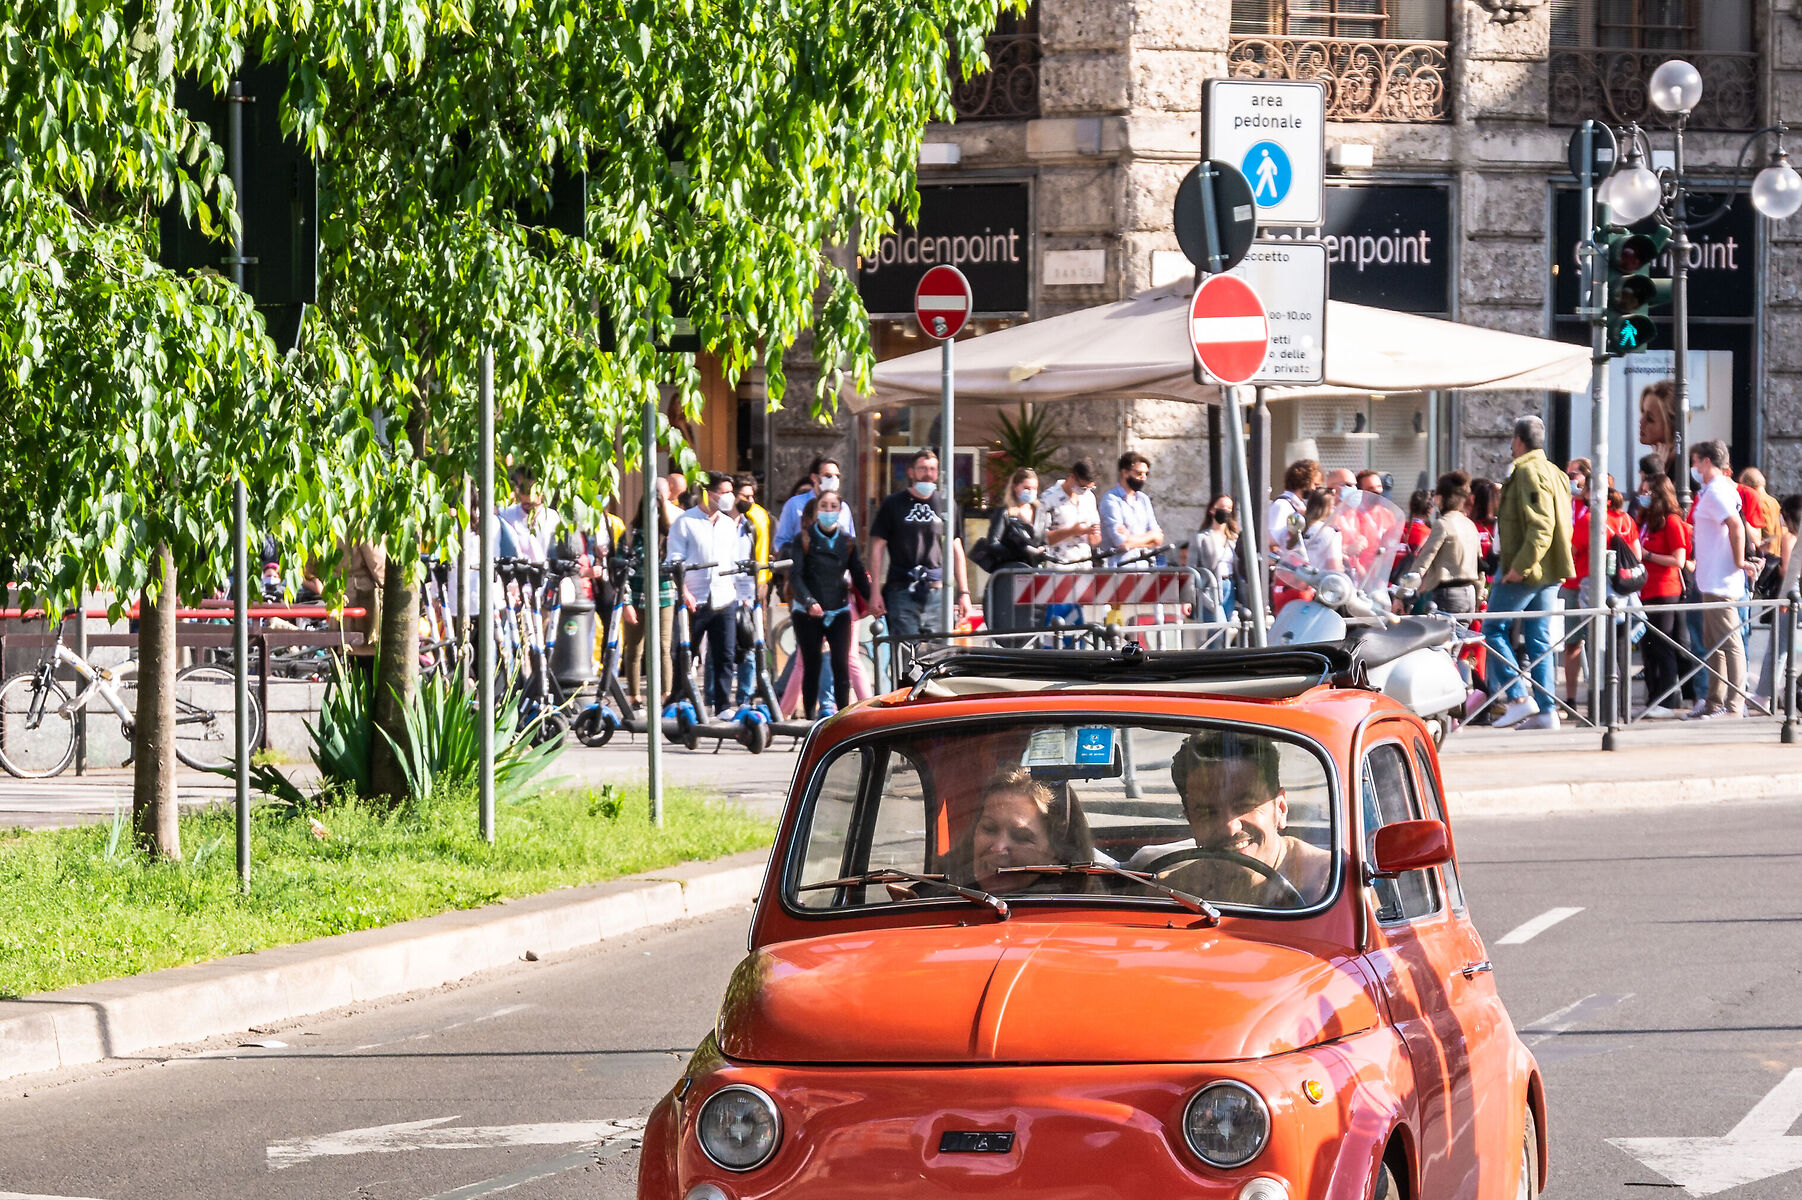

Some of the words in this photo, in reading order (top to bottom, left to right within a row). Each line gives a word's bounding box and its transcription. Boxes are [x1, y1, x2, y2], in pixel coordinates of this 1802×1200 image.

[1251, 95, 1284, 107] area
[1234, 114, 1302, 129] pedonale
[1280, 349, 1306, 359] delle
